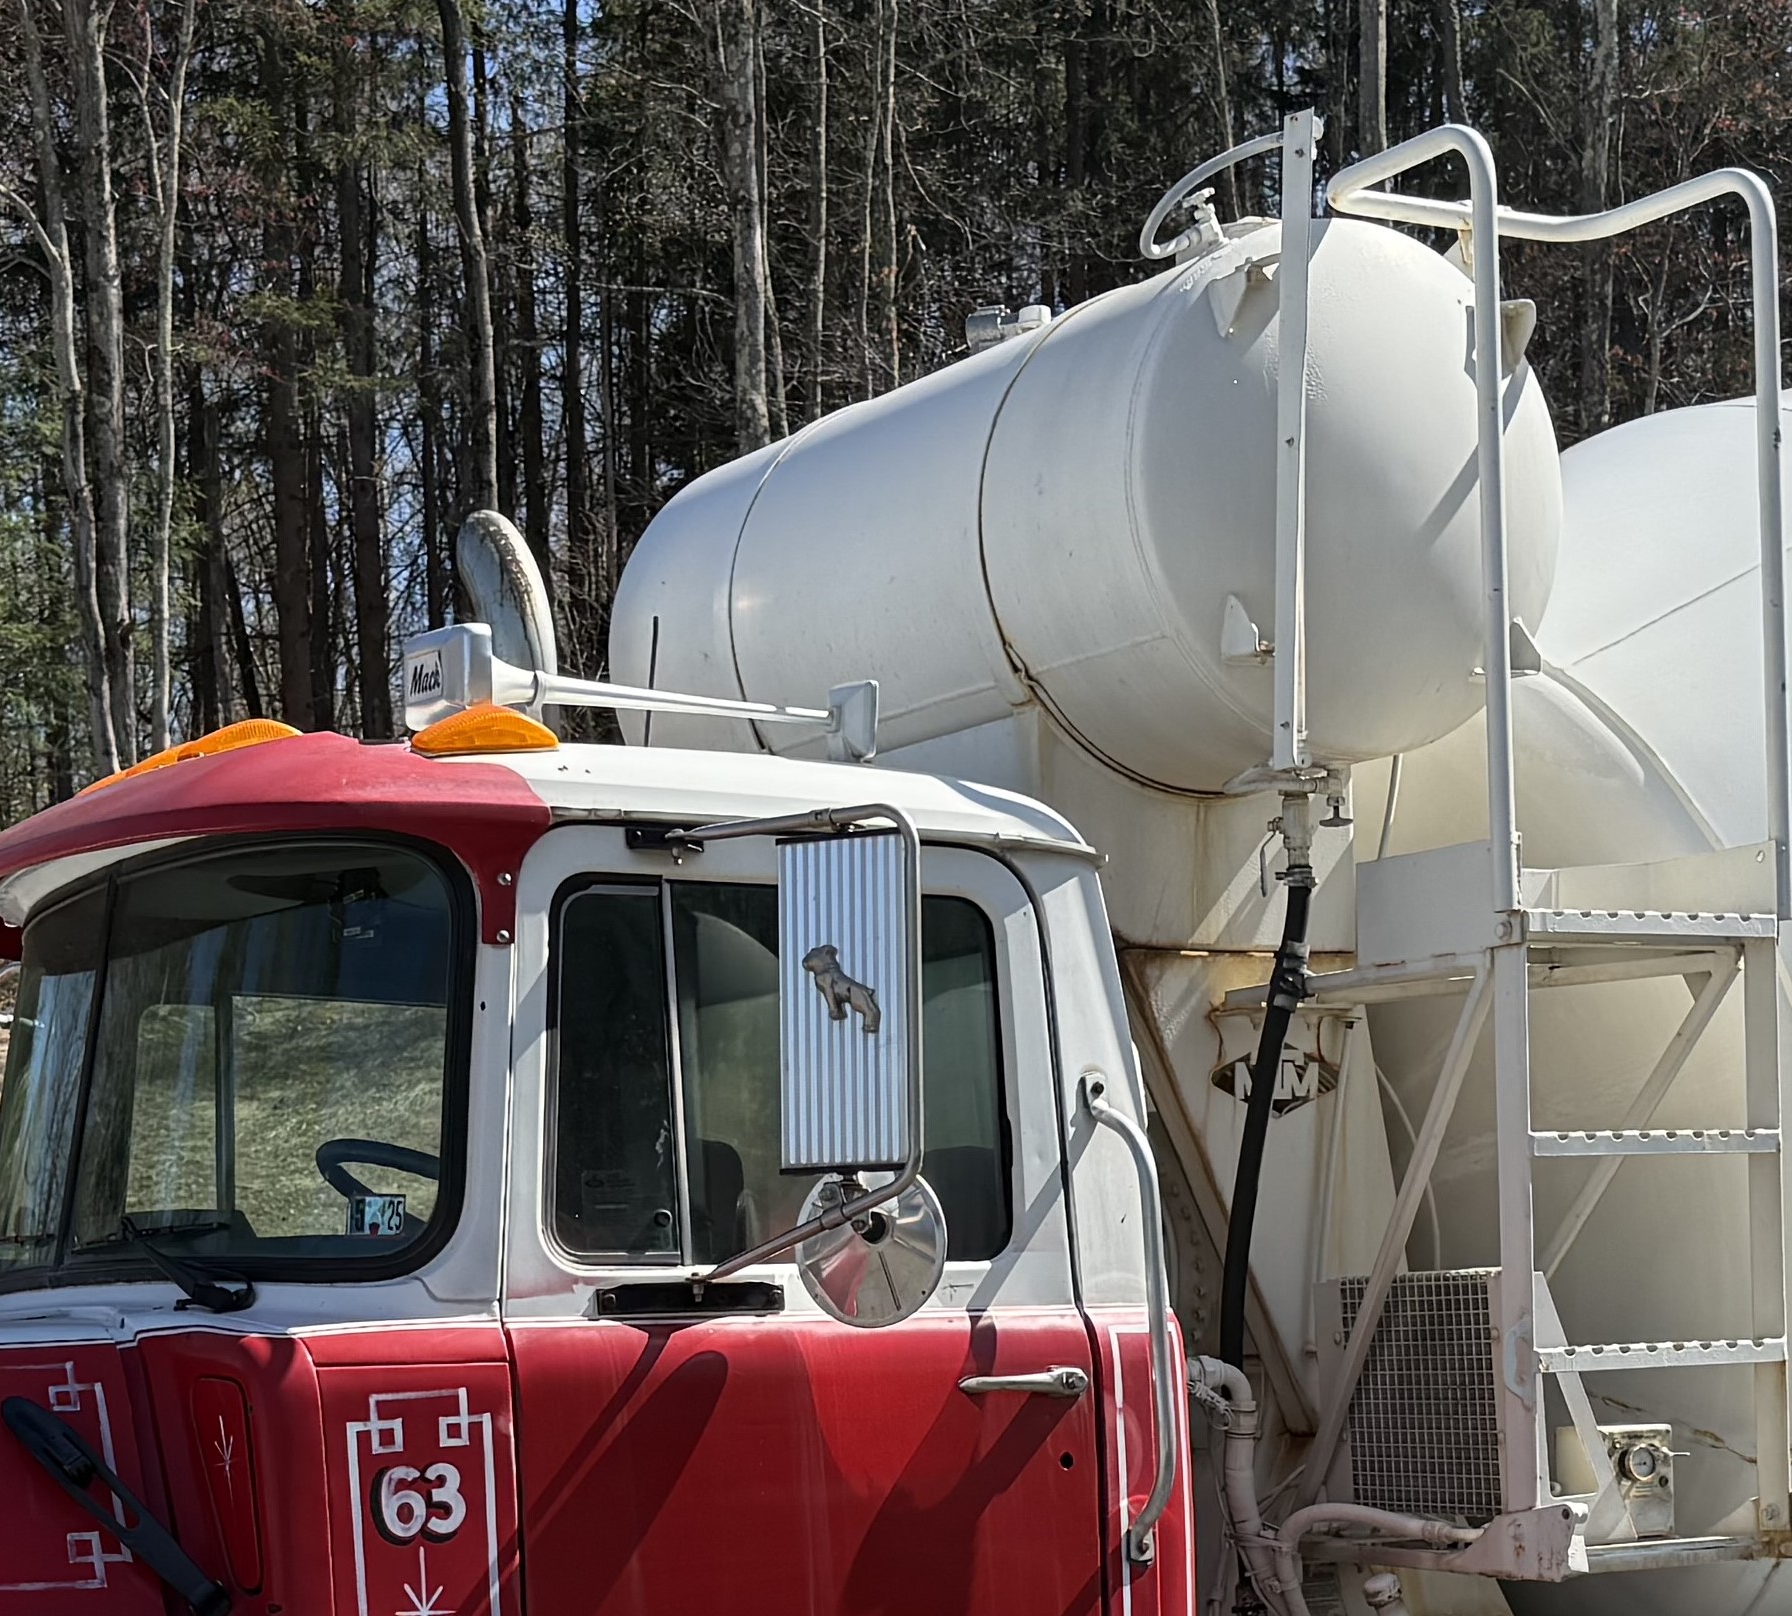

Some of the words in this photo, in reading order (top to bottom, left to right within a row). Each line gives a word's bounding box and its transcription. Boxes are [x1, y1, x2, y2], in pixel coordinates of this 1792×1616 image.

[409, 660, 441, 697] Mack
[387, 1199, 403, 1231] 25
[372, 1462, 467, 1543] 63
